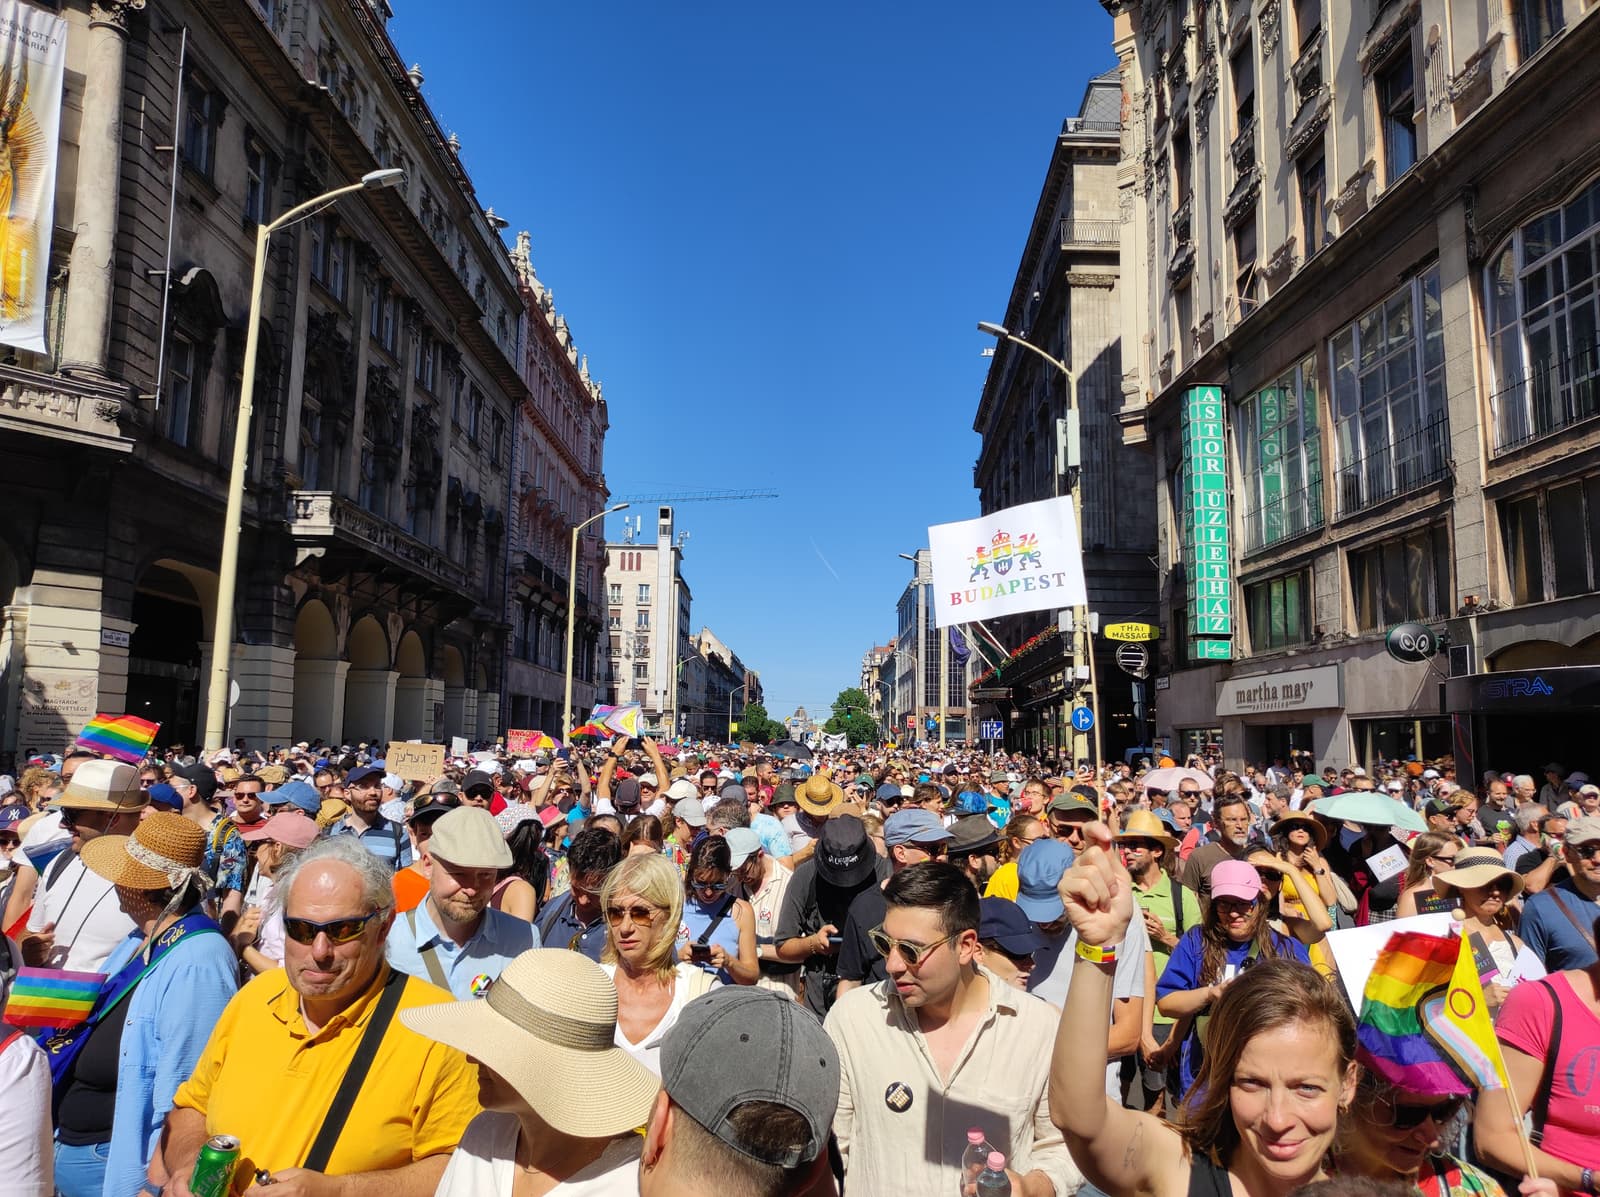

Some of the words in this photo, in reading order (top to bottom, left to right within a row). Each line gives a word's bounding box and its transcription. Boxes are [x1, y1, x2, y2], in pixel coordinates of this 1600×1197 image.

[1201, 388, 1221, 473] ASTOR
[1206, 490, 1226, 632] ÜZLETHÁZ
[949, 571, 1067, 607] BUDAPEST
[1235, 681, 1278, 704] martha
[7, 808, 21, 821] NY
